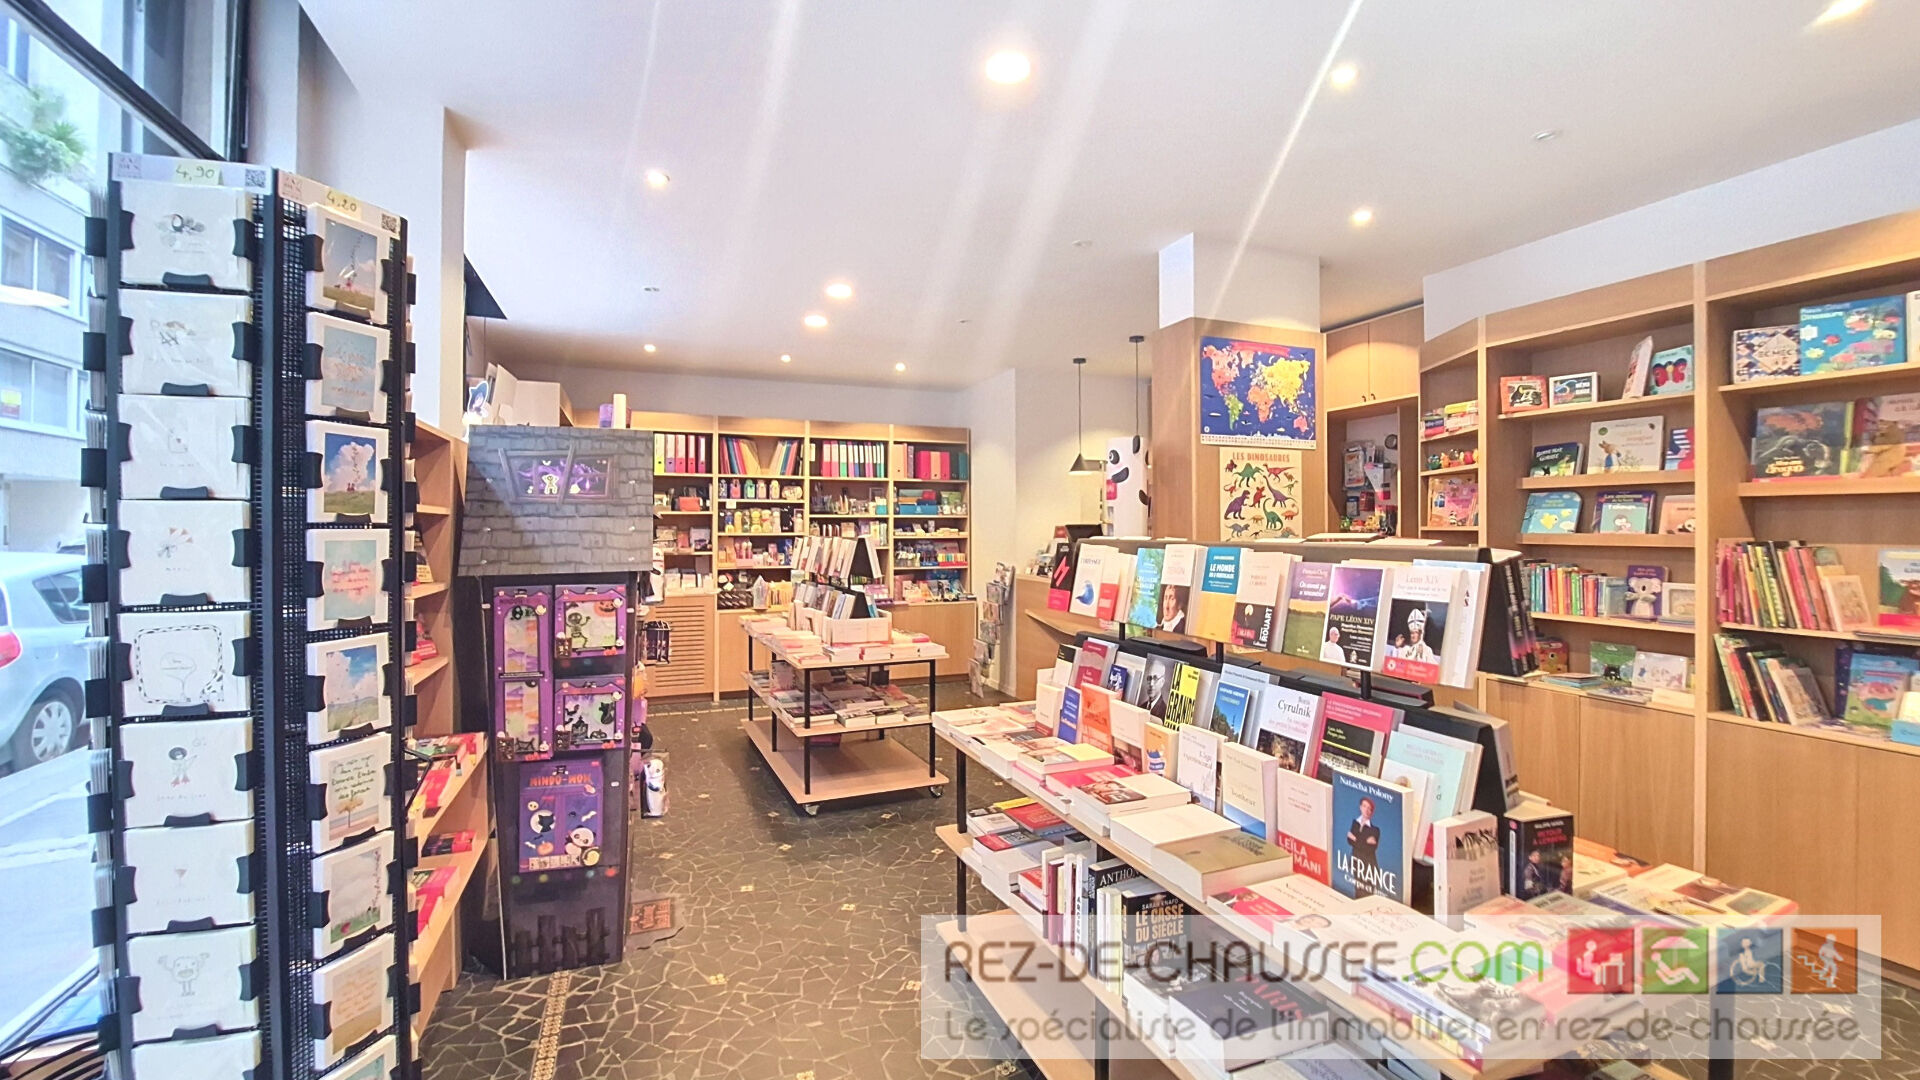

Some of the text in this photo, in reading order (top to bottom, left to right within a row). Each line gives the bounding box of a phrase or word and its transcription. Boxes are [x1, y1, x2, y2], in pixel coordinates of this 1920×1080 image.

[1232, 451, 1290, 463] LES DINOSAURES
[1261, 607, 1273, 643] ROUART
[1277, 699, 1311, 718] Cyrulnik
[1339, 775, 1394, 804] Natacha Polony
[1278, 834, 1308, 858] LEÏLA
[1337, 848, 1349, 873] LA
[1350, 855, 1397, 895] FRANCE
[1135, 903, 1185, 928] LE CASSE
[1135, 920, 1185, 943] DU SIÈCLE
